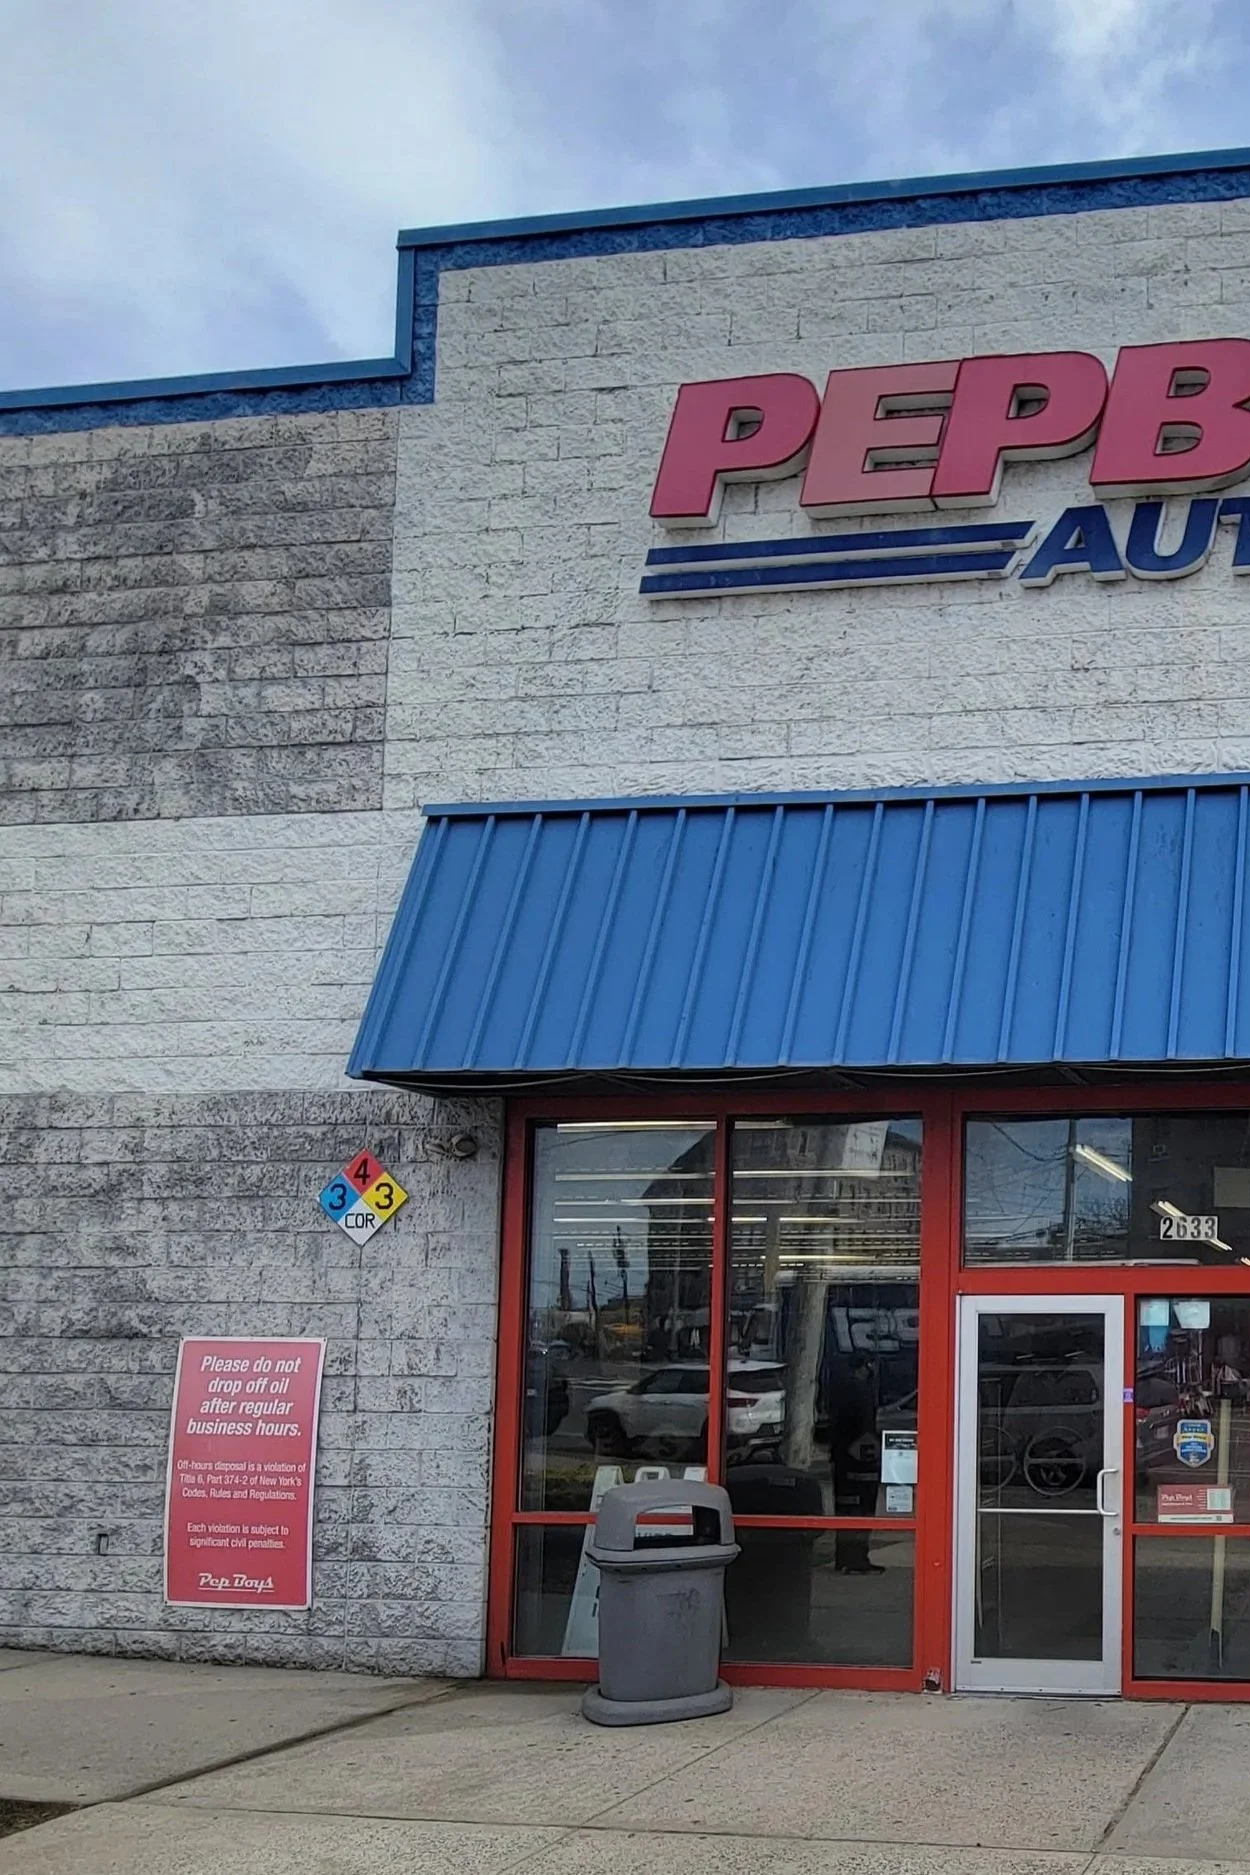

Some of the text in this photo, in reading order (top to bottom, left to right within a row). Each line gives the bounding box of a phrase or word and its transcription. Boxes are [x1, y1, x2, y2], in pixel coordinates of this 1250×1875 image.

[354, 1158, 370, 1186] 4
[328, 1183, 347, 1211] 3
[374, 1182, 394, 1210] 3
[344, 1212, 376, 1229] COR
[1161, 1216, 1217, 1239] 2633
[200, 1355, 302, 1373] Please do not
[208, 1377, 290, 1396] drop off oil
[200, 1397, 294, 1418] after regular
[186, 1418, 302, 1436] business hours.
[177, 1459, 306, 1473] Off-hours disposal is a violation of
[207, 1474, 222, 1484] Part
[224, 1475, 248, 1485] 374-2
[249, 1475, 258, 1485] of
[260, 1475, 277, 1486] New
[278, 1476, 302, 1487] York's
[210, 1487, 232, 1498] Rules
[232, 1488, 248, 1499] and
[249, 1489, 297, 1501] Regulations.
[187, 1522, 289, 1536] Each violation is subject to
[190, 1536, 286, 1550] significant civil penalties.
[199, 1573, 275, 1593] Pep Boys
